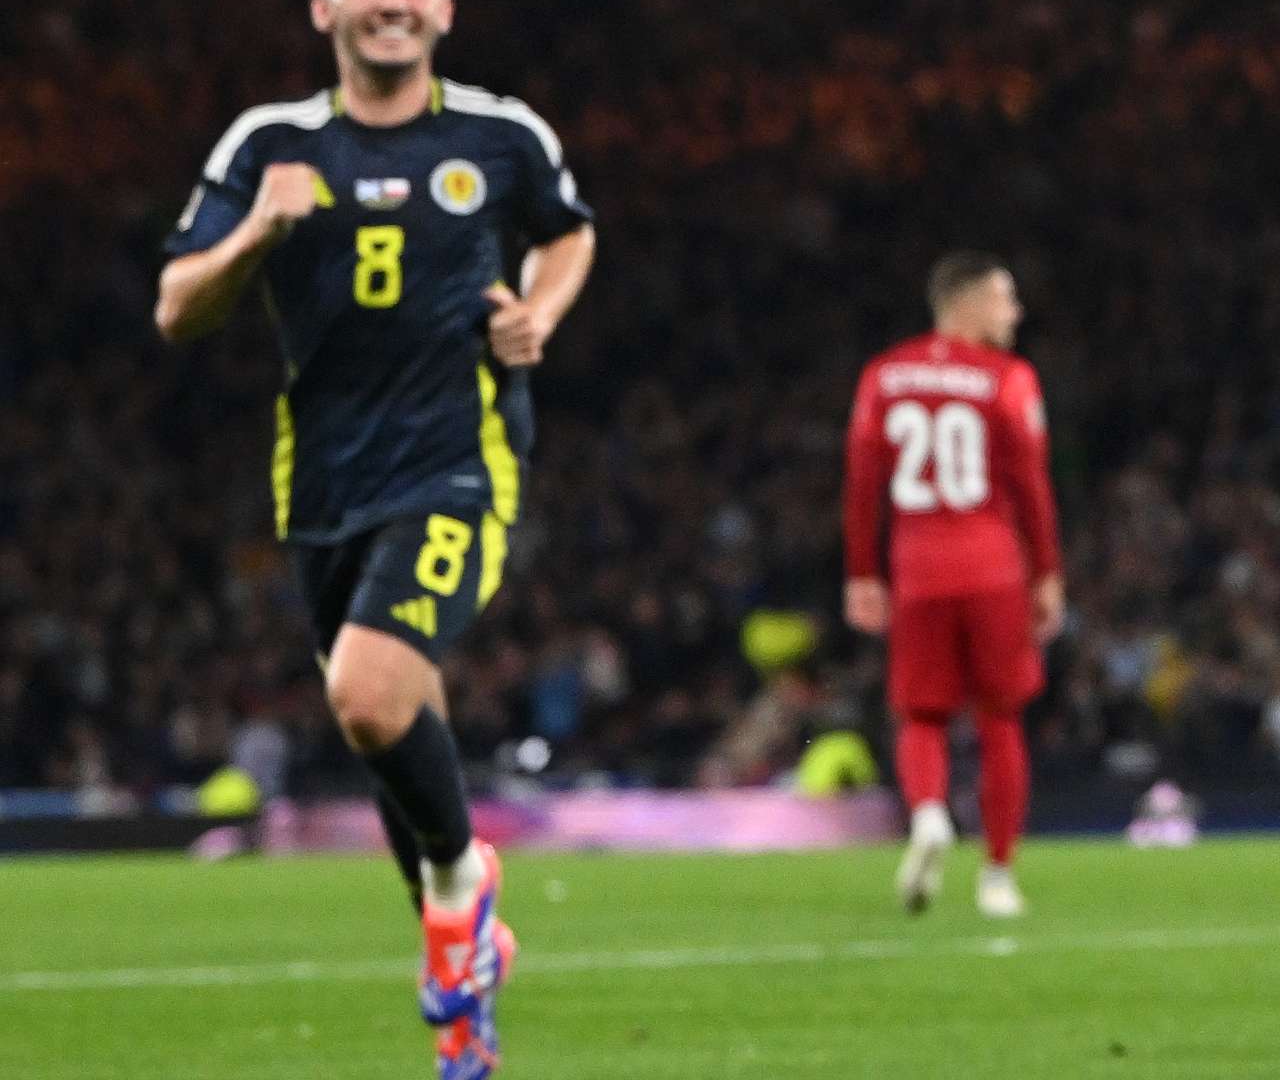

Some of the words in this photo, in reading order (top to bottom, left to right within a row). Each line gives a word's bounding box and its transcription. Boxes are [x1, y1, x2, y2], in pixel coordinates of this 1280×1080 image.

[353, 225, 405, 308] 8
[885, 400, 991, 512] 20
[415, 513, 473, 596] 8
